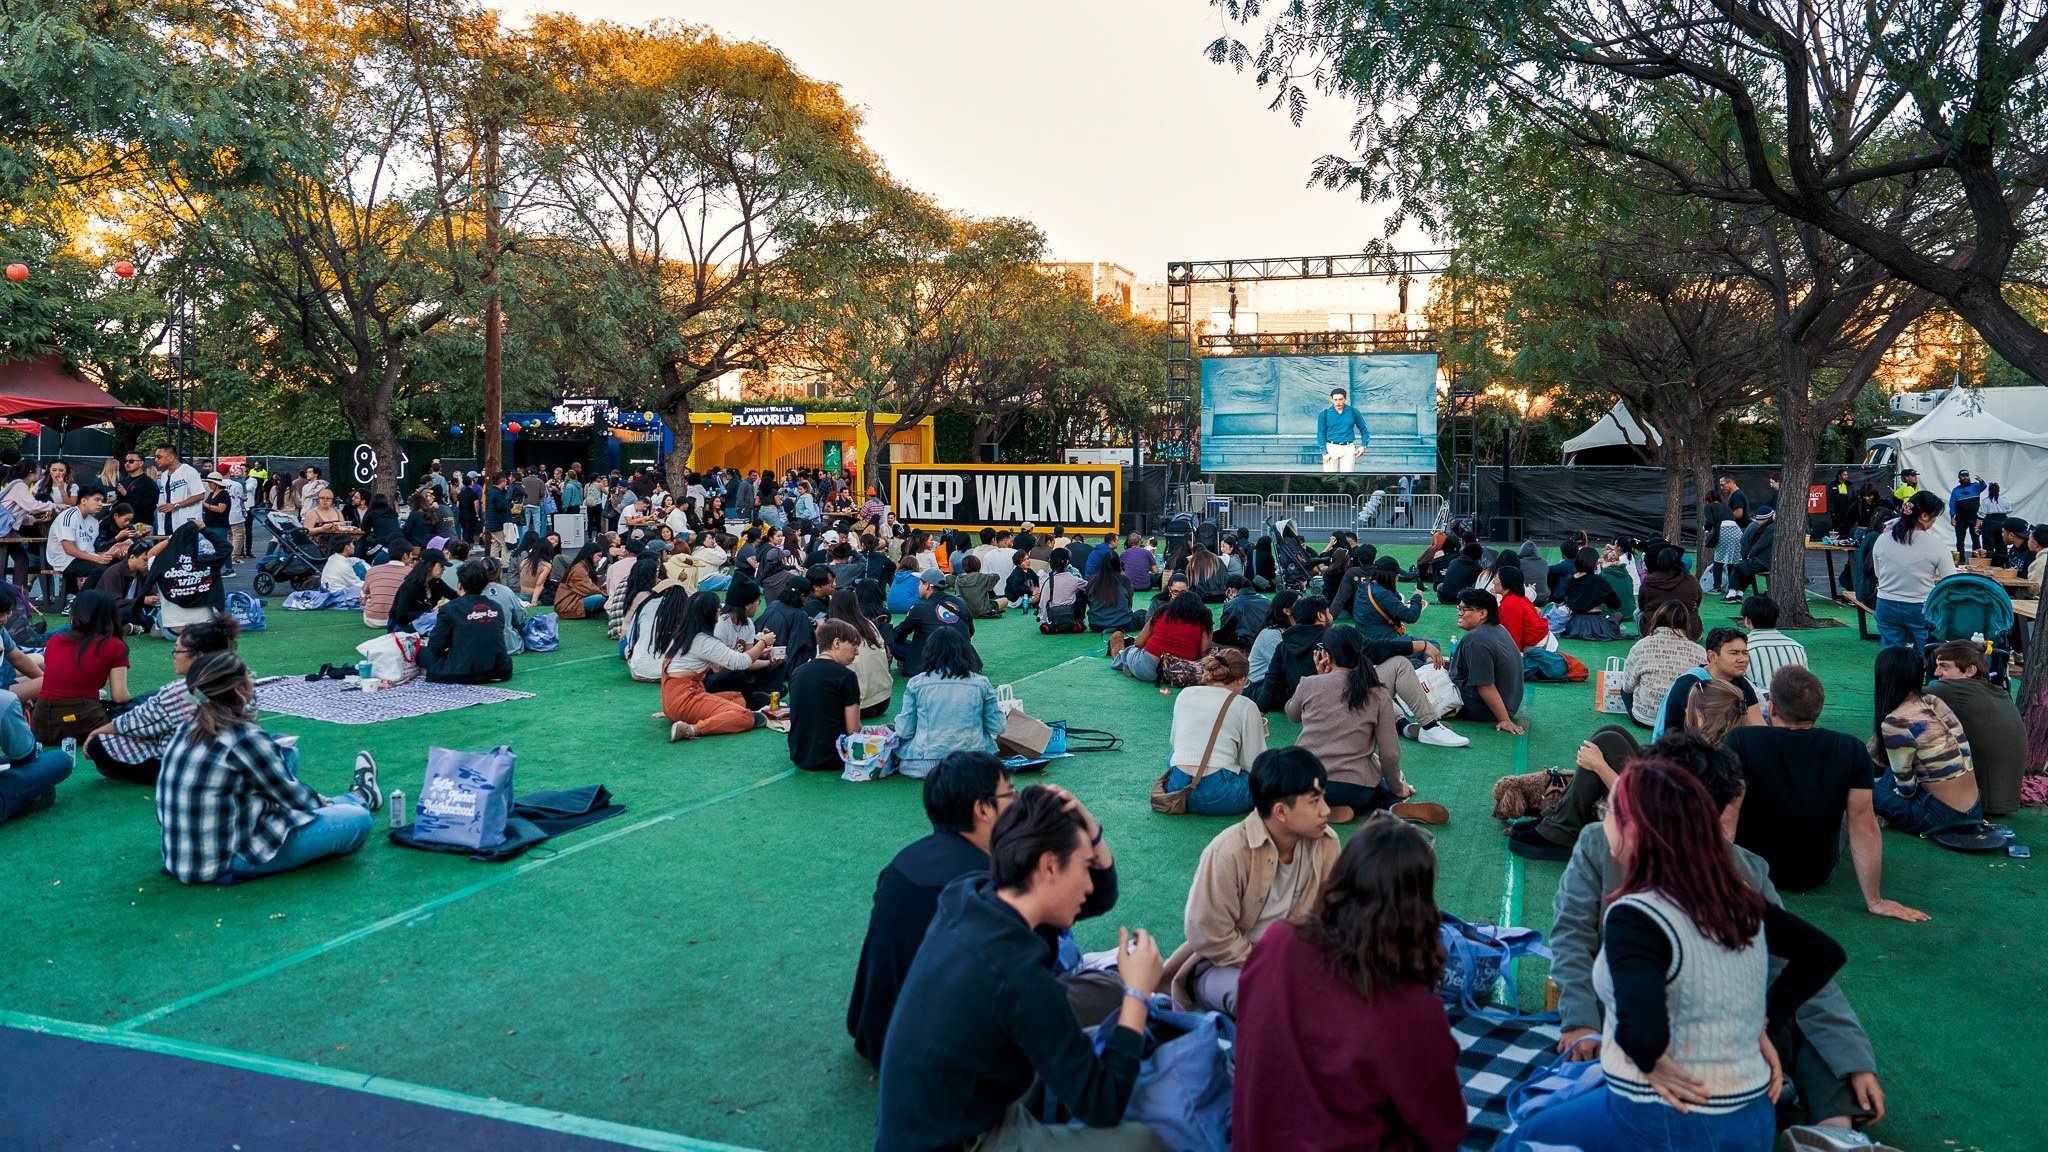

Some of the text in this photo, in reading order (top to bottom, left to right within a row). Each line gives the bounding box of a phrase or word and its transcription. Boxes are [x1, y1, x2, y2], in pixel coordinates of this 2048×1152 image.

[899, 474, 1112, 523] KEEP WALKING
[178, 576, 202, 586] with
